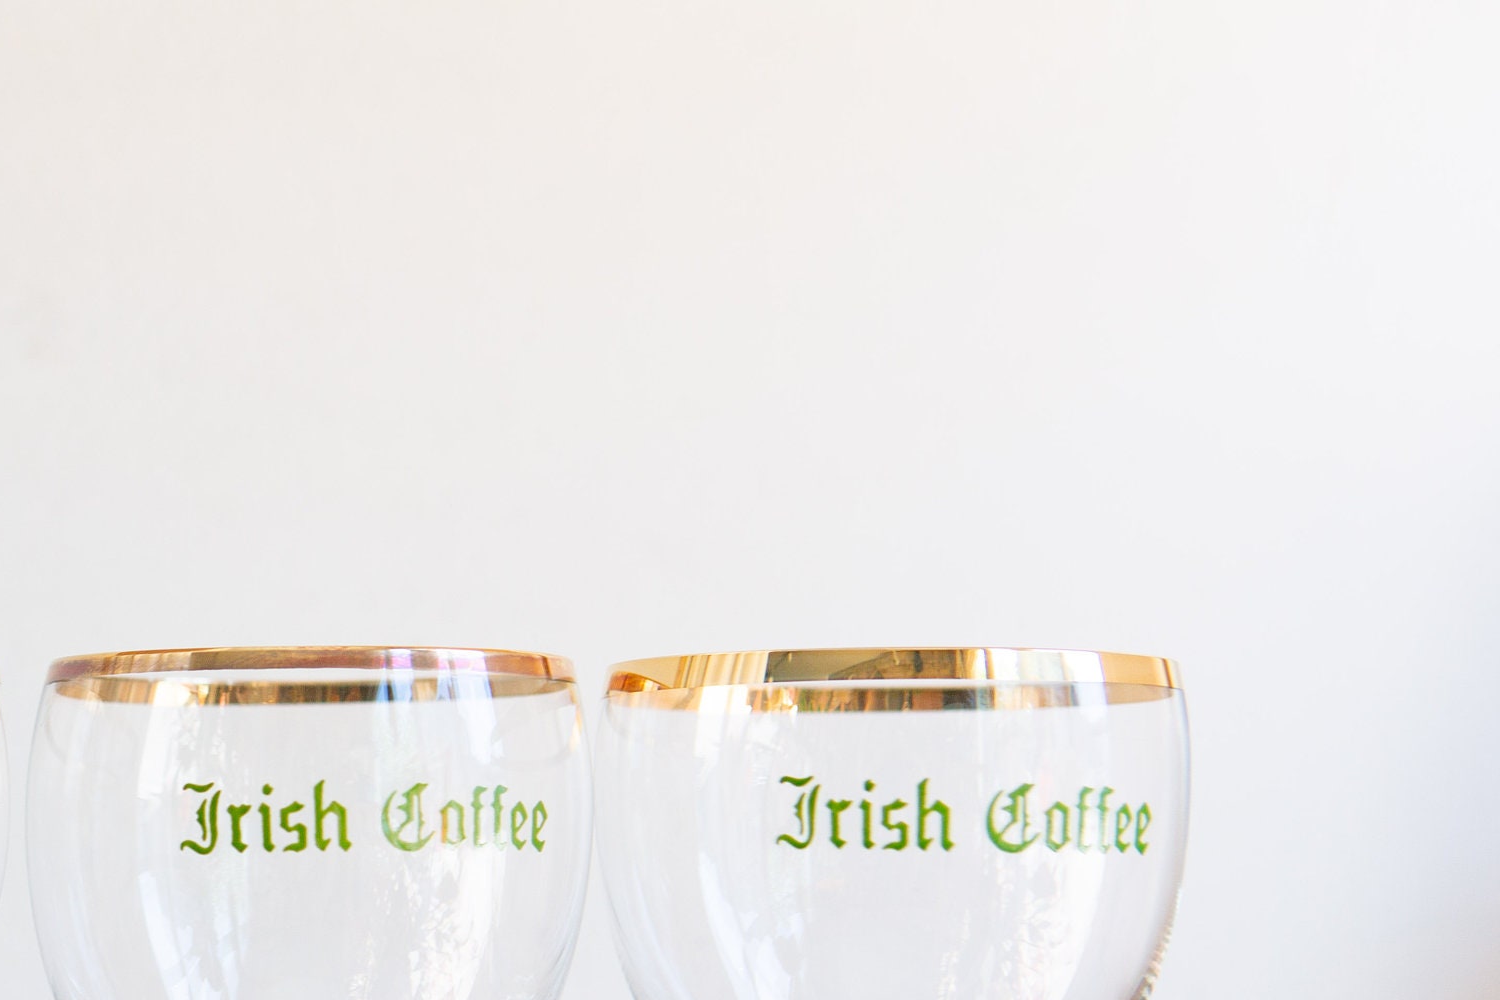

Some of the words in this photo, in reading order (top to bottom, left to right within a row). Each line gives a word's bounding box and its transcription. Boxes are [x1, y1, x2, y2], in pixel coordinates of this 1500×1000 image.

[180, 780, 352, 855] Irish
[380, 782, 548, 852] Coffee
[776, 775, 955, 852] Irish
[986, 783, 1152, 855] Coffee
